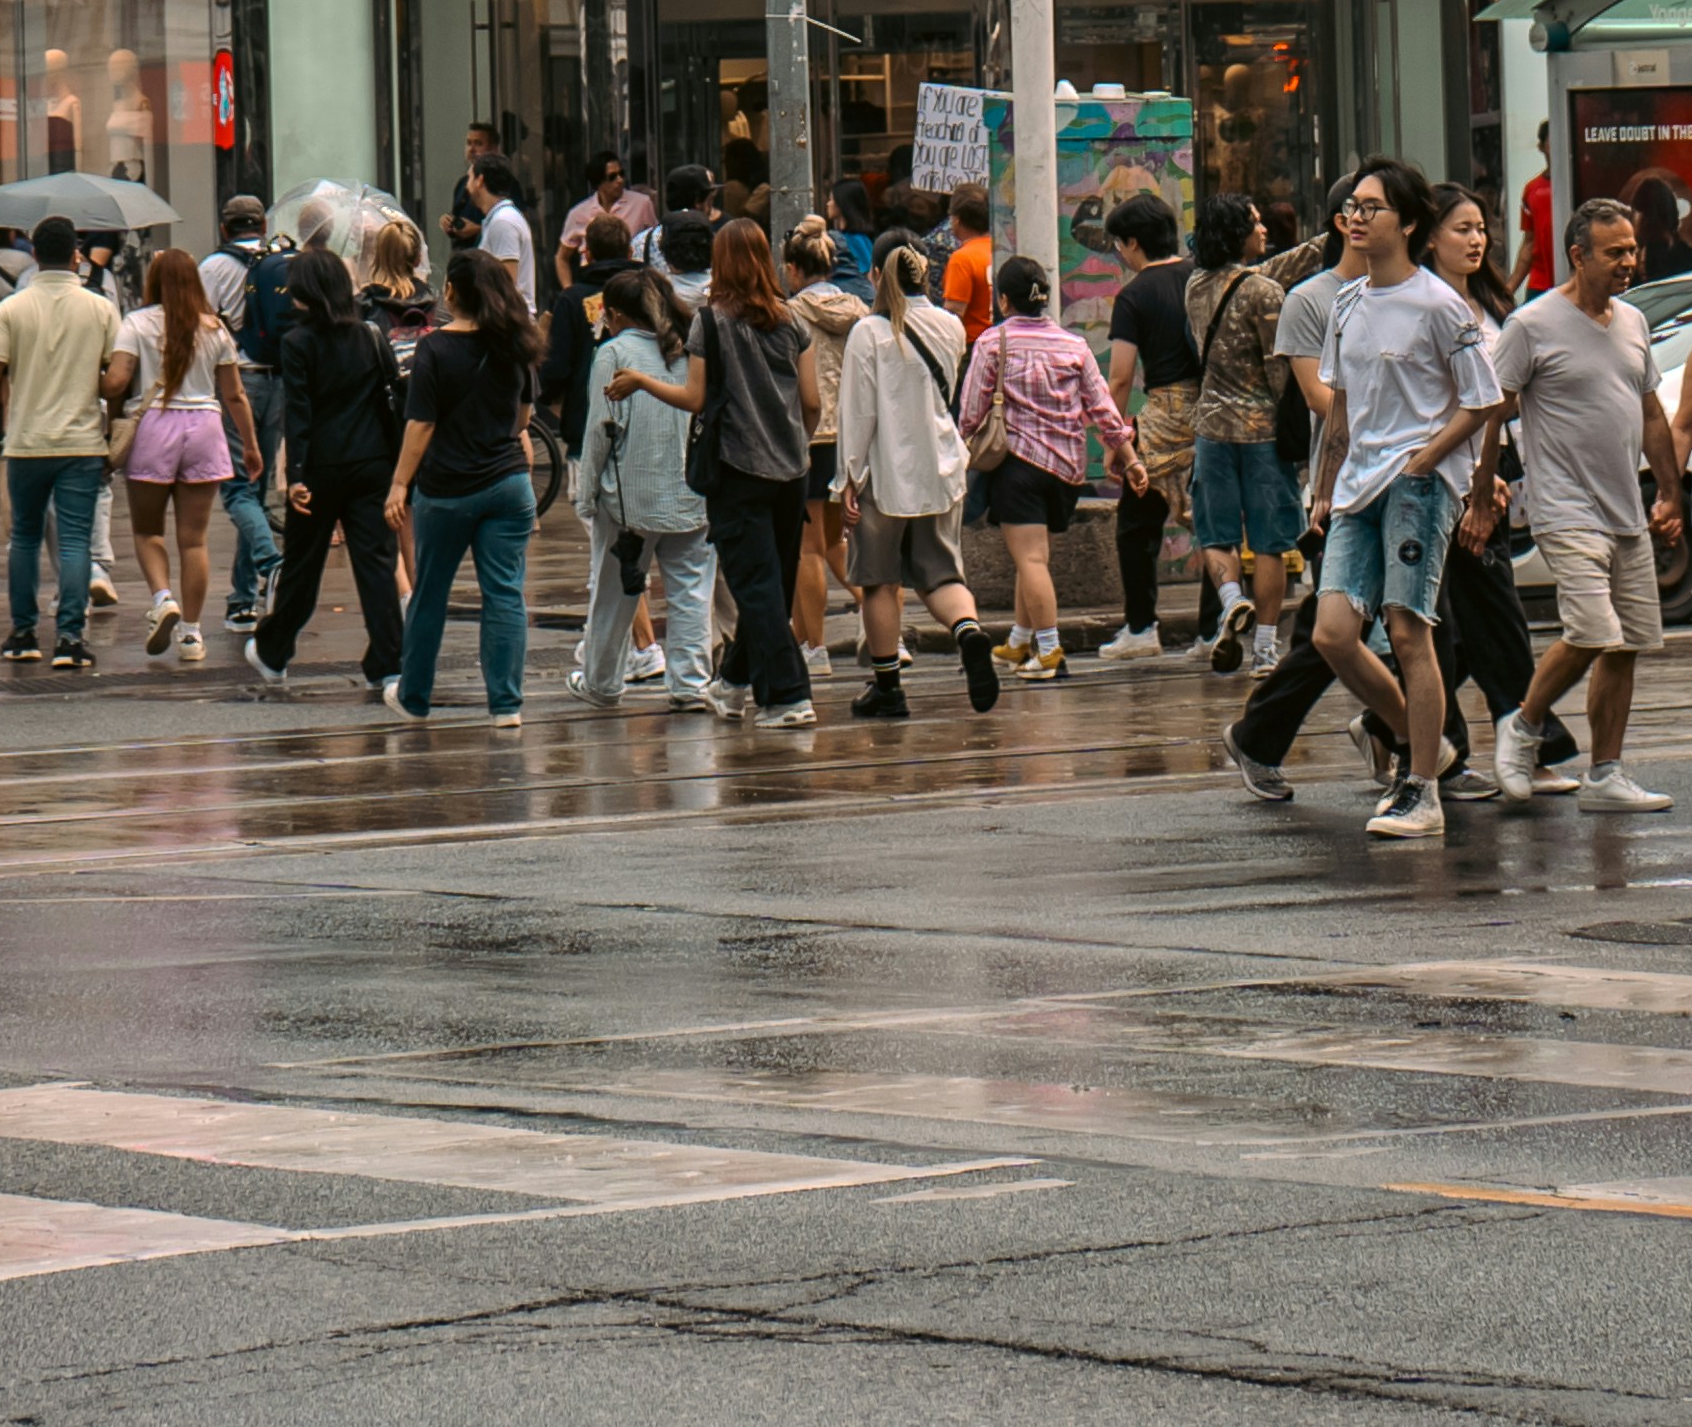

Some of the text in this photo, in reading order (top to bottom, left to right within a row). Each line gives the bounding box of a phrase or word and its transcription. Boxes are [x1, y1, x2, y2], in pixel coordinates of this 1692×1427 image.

[1585, 125, 1617, 143] LEAVE
[1619, 124, 1656, 142] DOUBT
[1658, 124, 1671, 141] IN
